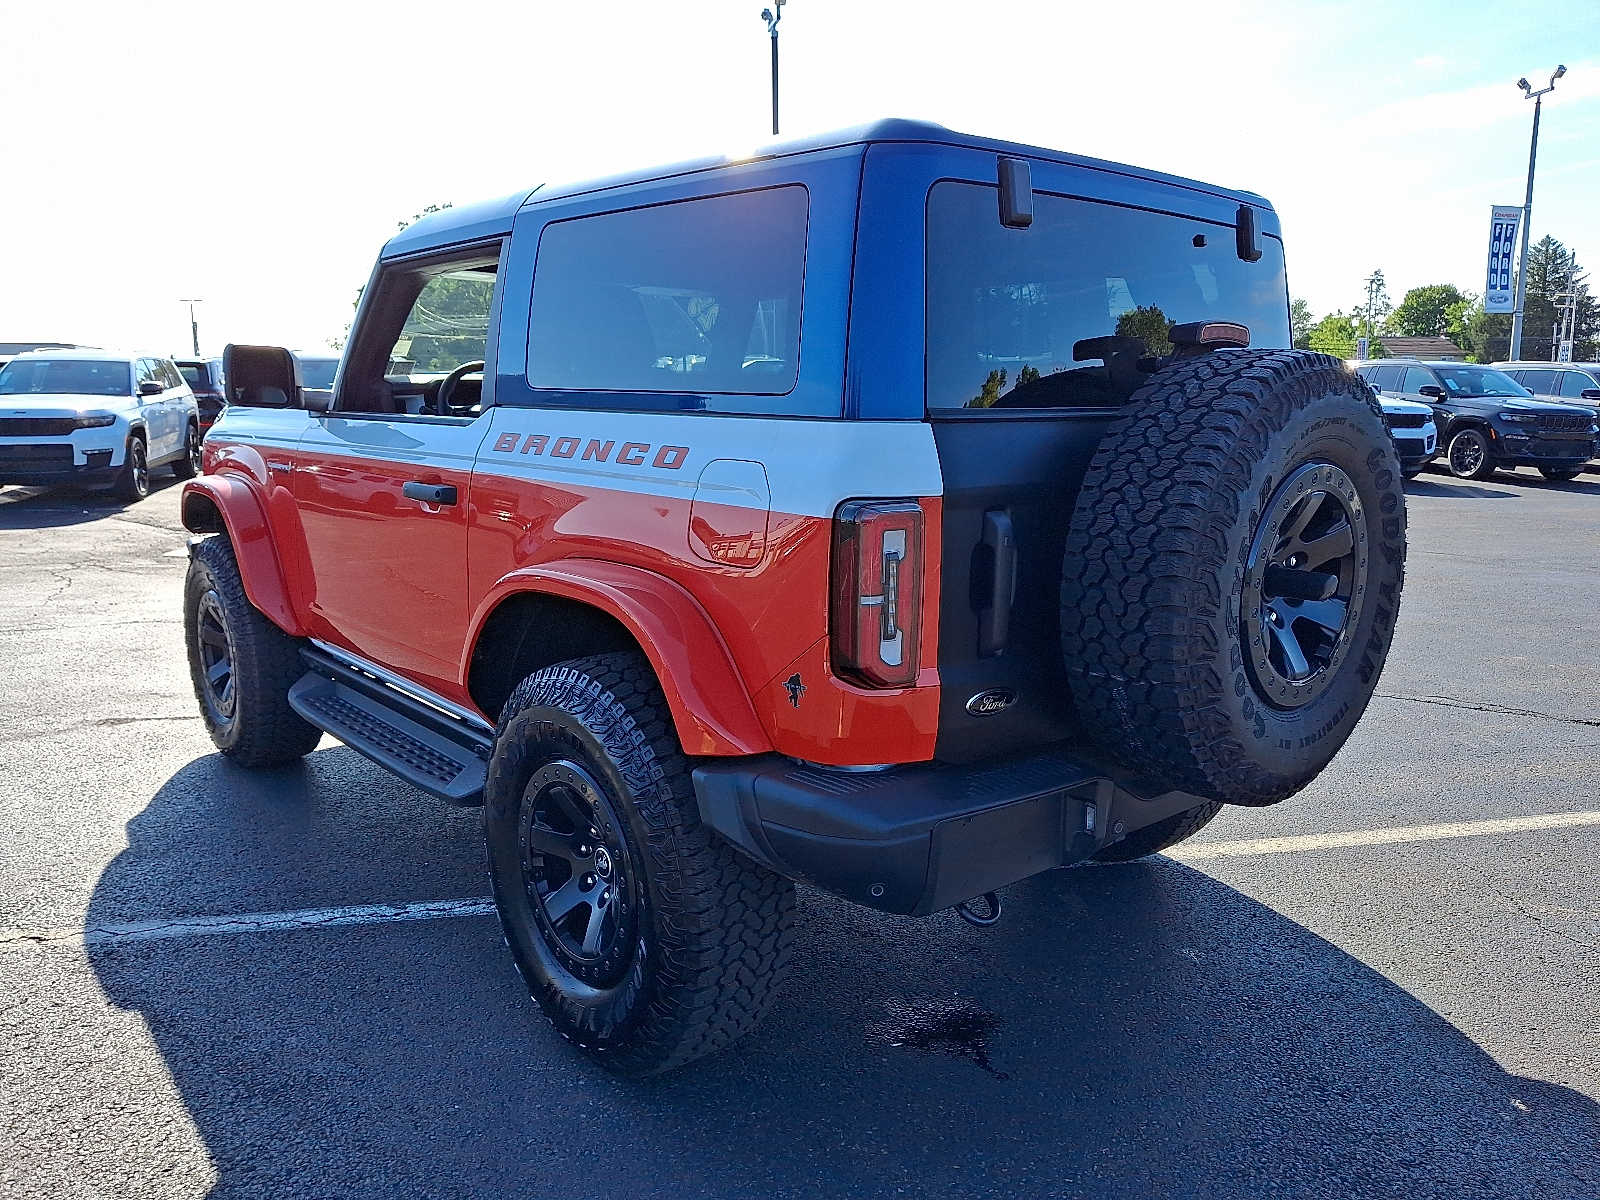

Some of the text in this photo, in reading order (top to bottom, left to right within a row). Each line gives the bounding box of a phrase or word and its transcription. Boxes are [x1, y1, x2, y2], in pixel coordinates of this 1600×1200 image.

[1490, 224, 1502, 285] FORD
[1501, 224, 1513, 285] FORD
[493, 432, 689, 469] BRONCO
[980, 695, 1006, 711] Ford
